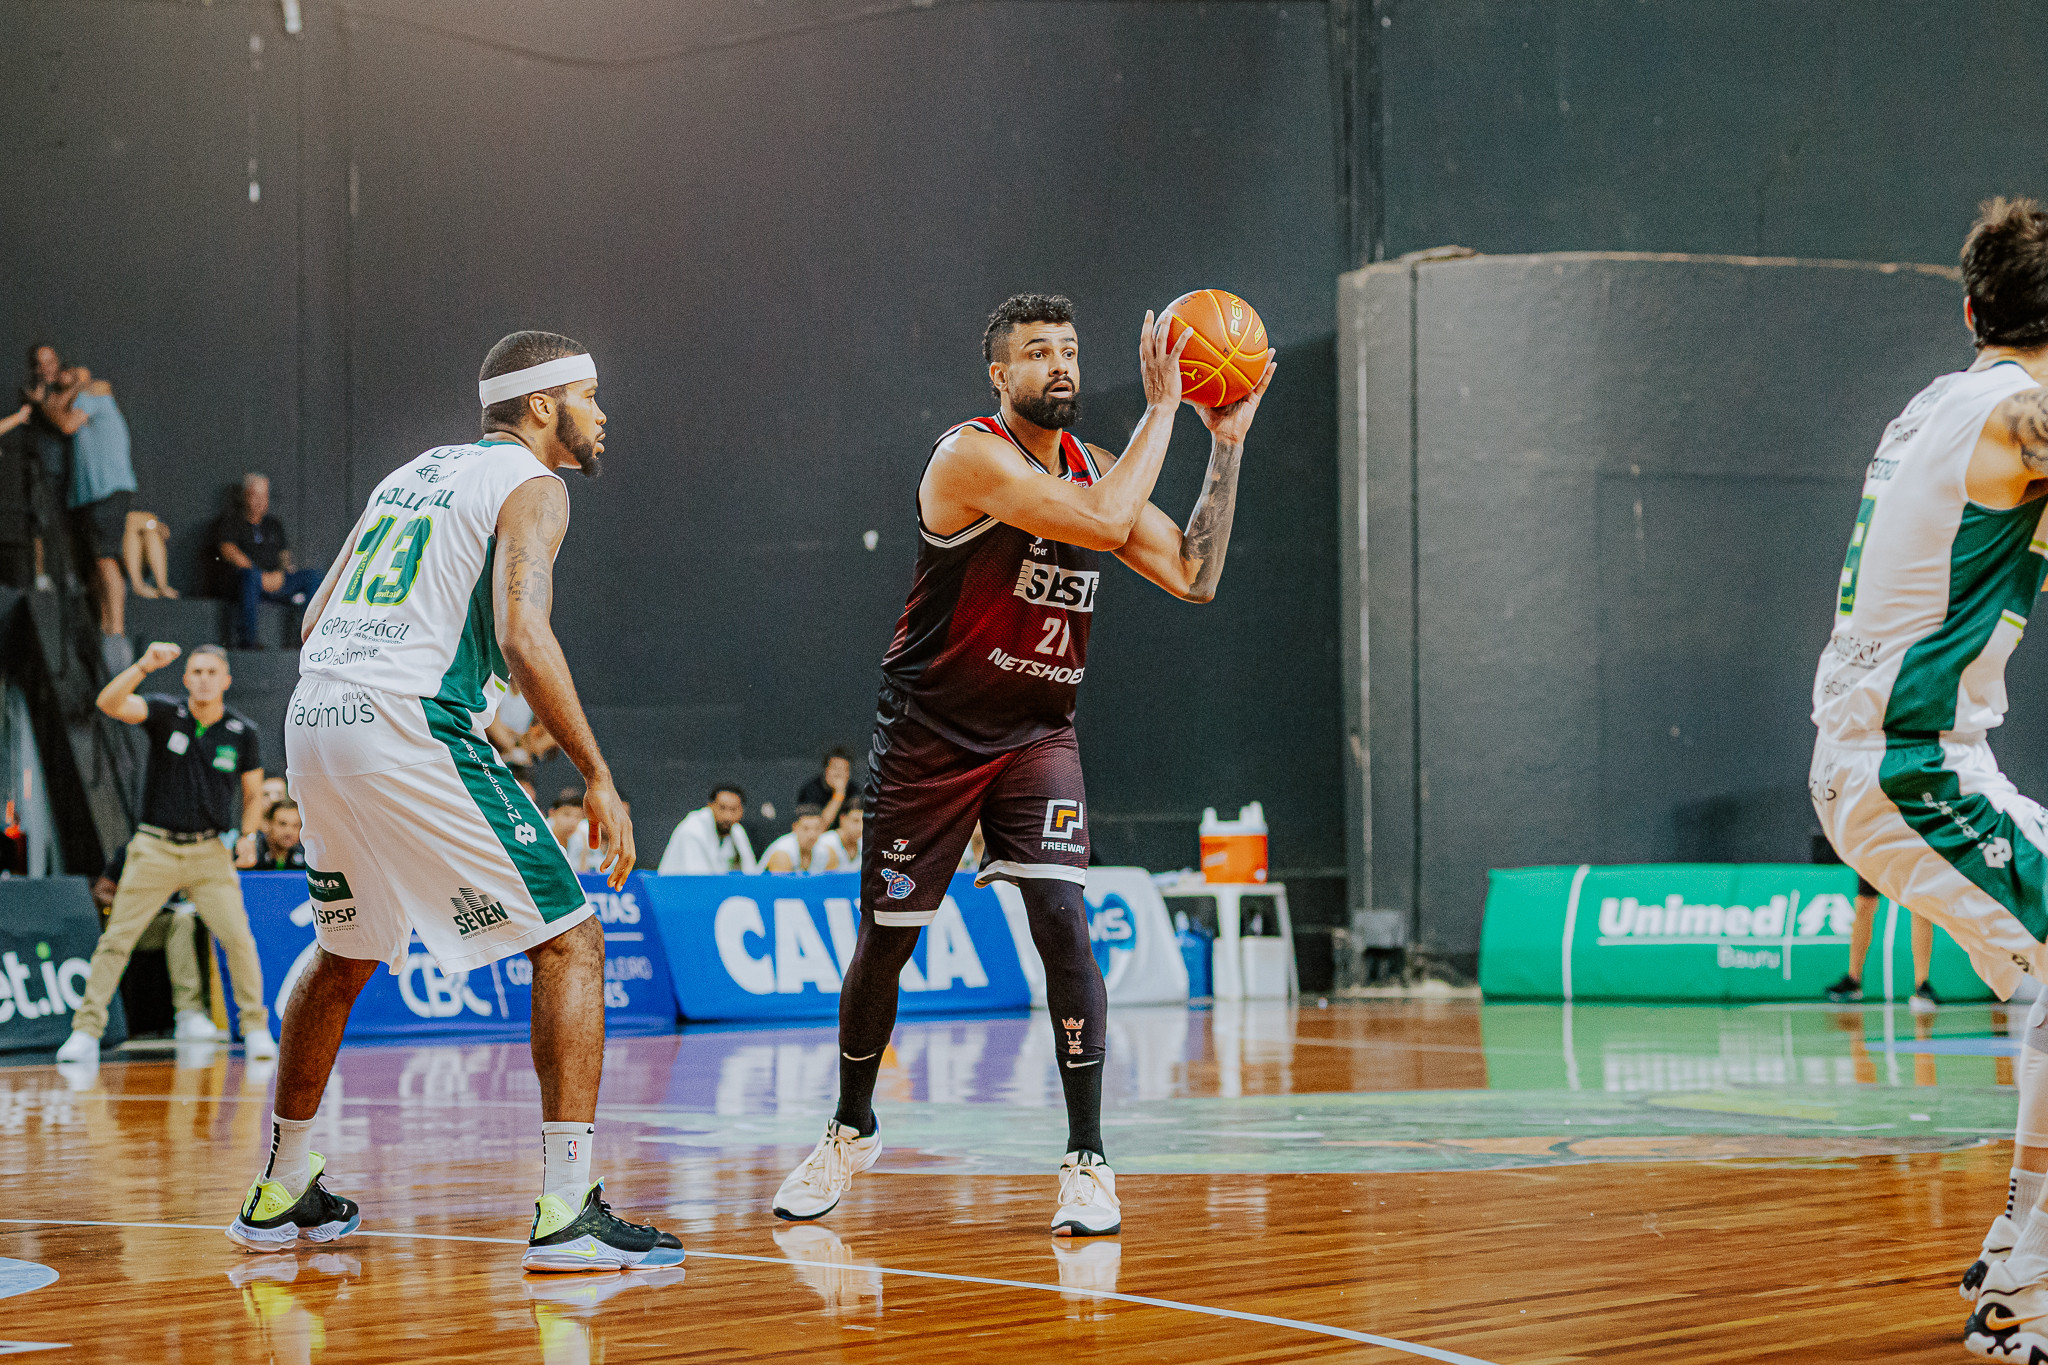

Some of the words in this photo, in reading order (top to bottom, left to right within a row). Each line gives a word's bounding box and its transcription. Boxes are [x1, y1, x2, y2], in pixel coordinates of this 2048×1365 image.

[341, 515, 433, 606] 13
[1034, 616, 1070, 657] 21
[881, 850, 917, 862] Topper
[1041, 841, 1086, 855] FREEWAY
[453, 901, 509, 936] SEVEN
[1599, 894, 1788, 937] Unimed
